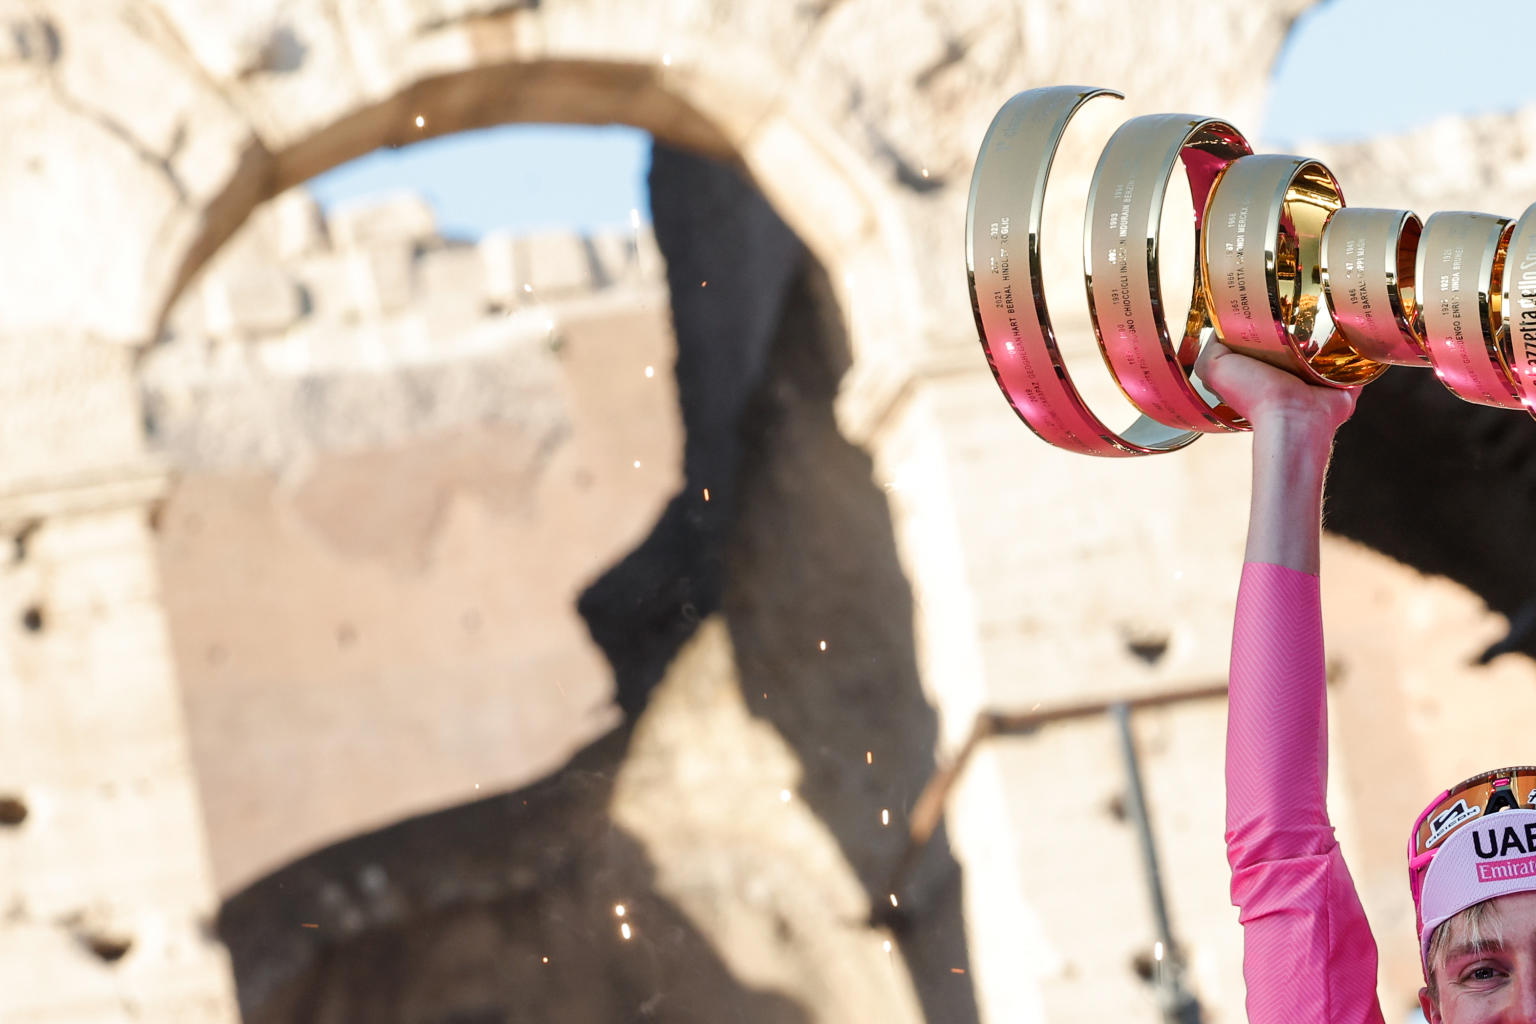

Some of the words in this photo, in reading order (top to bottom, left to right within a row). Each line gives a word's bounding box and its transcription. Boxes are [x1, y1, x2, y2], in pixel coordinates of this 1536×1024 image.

[1119, 205, 1131, 237] INDURAIN
[1237, 267, 1247, 291] MOTTA
[1005, 285, 1015, 314] BERNAL
[1240, 293, 1251, 320] ADORNI
